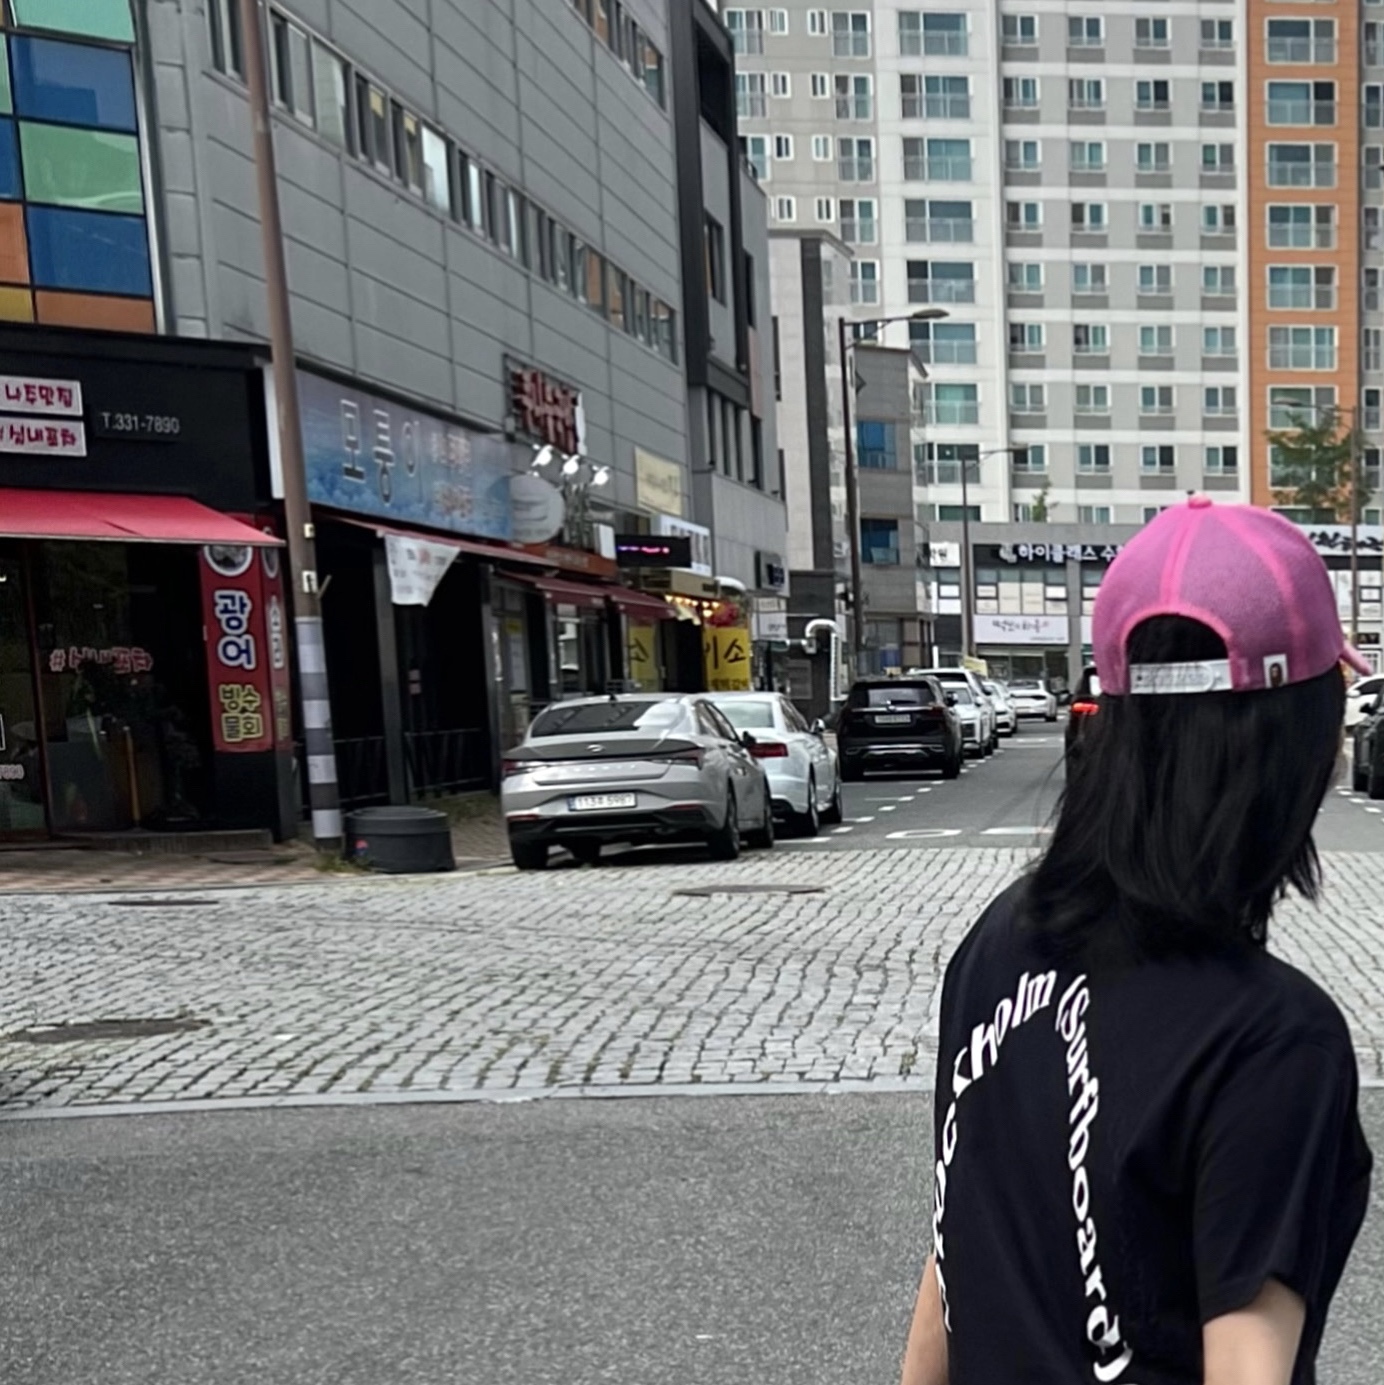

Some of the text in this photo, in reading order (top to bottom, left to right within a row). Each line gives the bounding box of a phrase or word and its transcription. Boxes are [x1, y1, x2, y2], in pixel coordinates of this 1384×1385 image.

[1018, 543, 1098, 564] 하이클래스
[215, 591, 255, 668] 광어
[1055, 974, 1133, 1382] (Surfboard)
